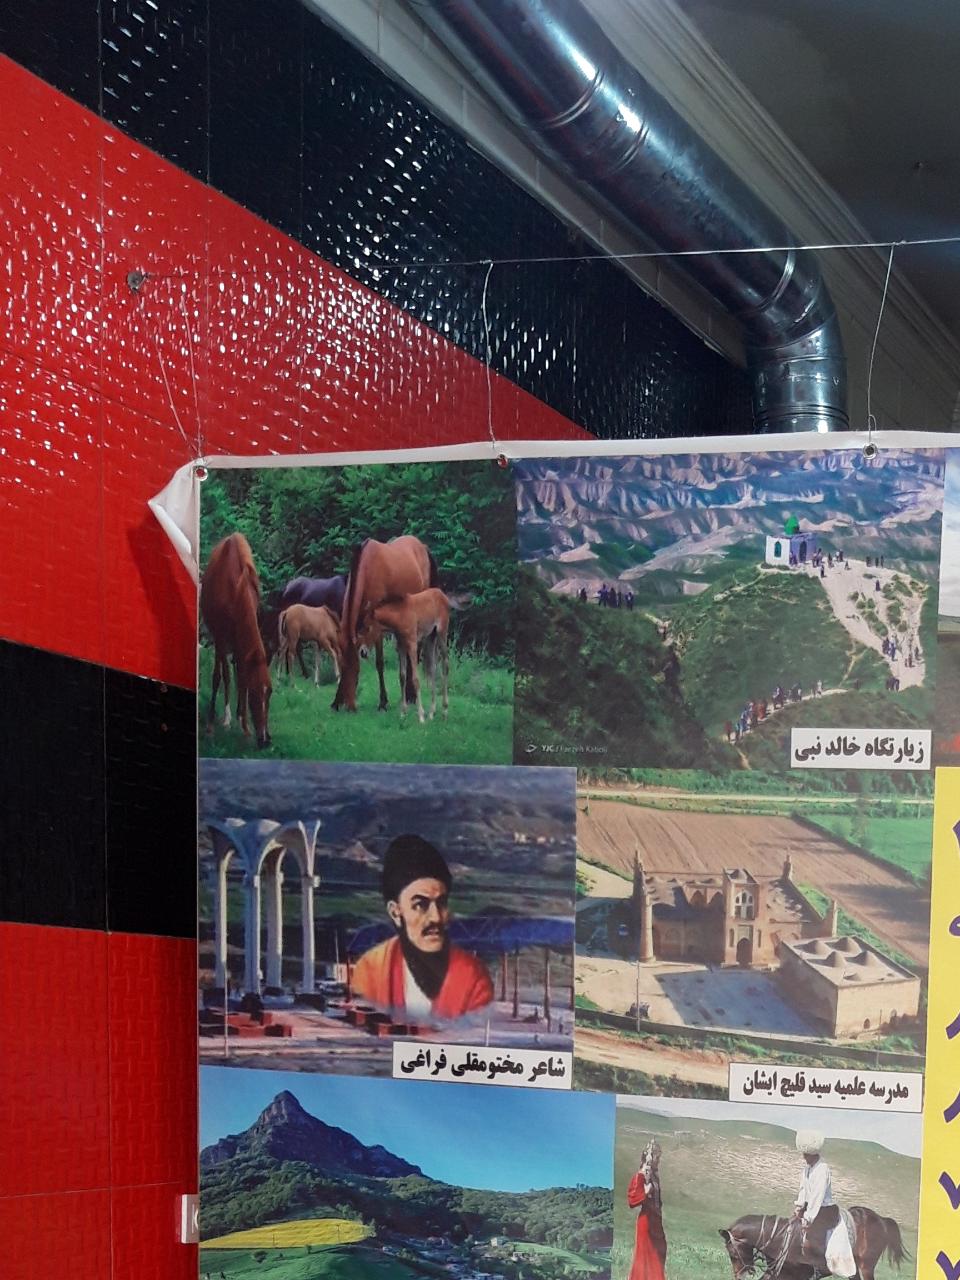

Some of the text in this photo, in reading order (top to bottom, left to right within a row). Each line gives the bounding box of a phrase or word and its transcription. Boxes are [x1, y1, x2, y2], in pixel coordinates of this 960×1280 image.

[795, 736, 924, 763] زیارتگاه خالد نبی
[401, 1048, 565, 1082] شاعر مختومقلی فراغی
[743, 1069, 778, 1095] ایشان
[808, 1078, 831, 1099] سید
[834, 1076, 866, 1100] علمیه
[869, 1081, 909, 1104] مدرسه
